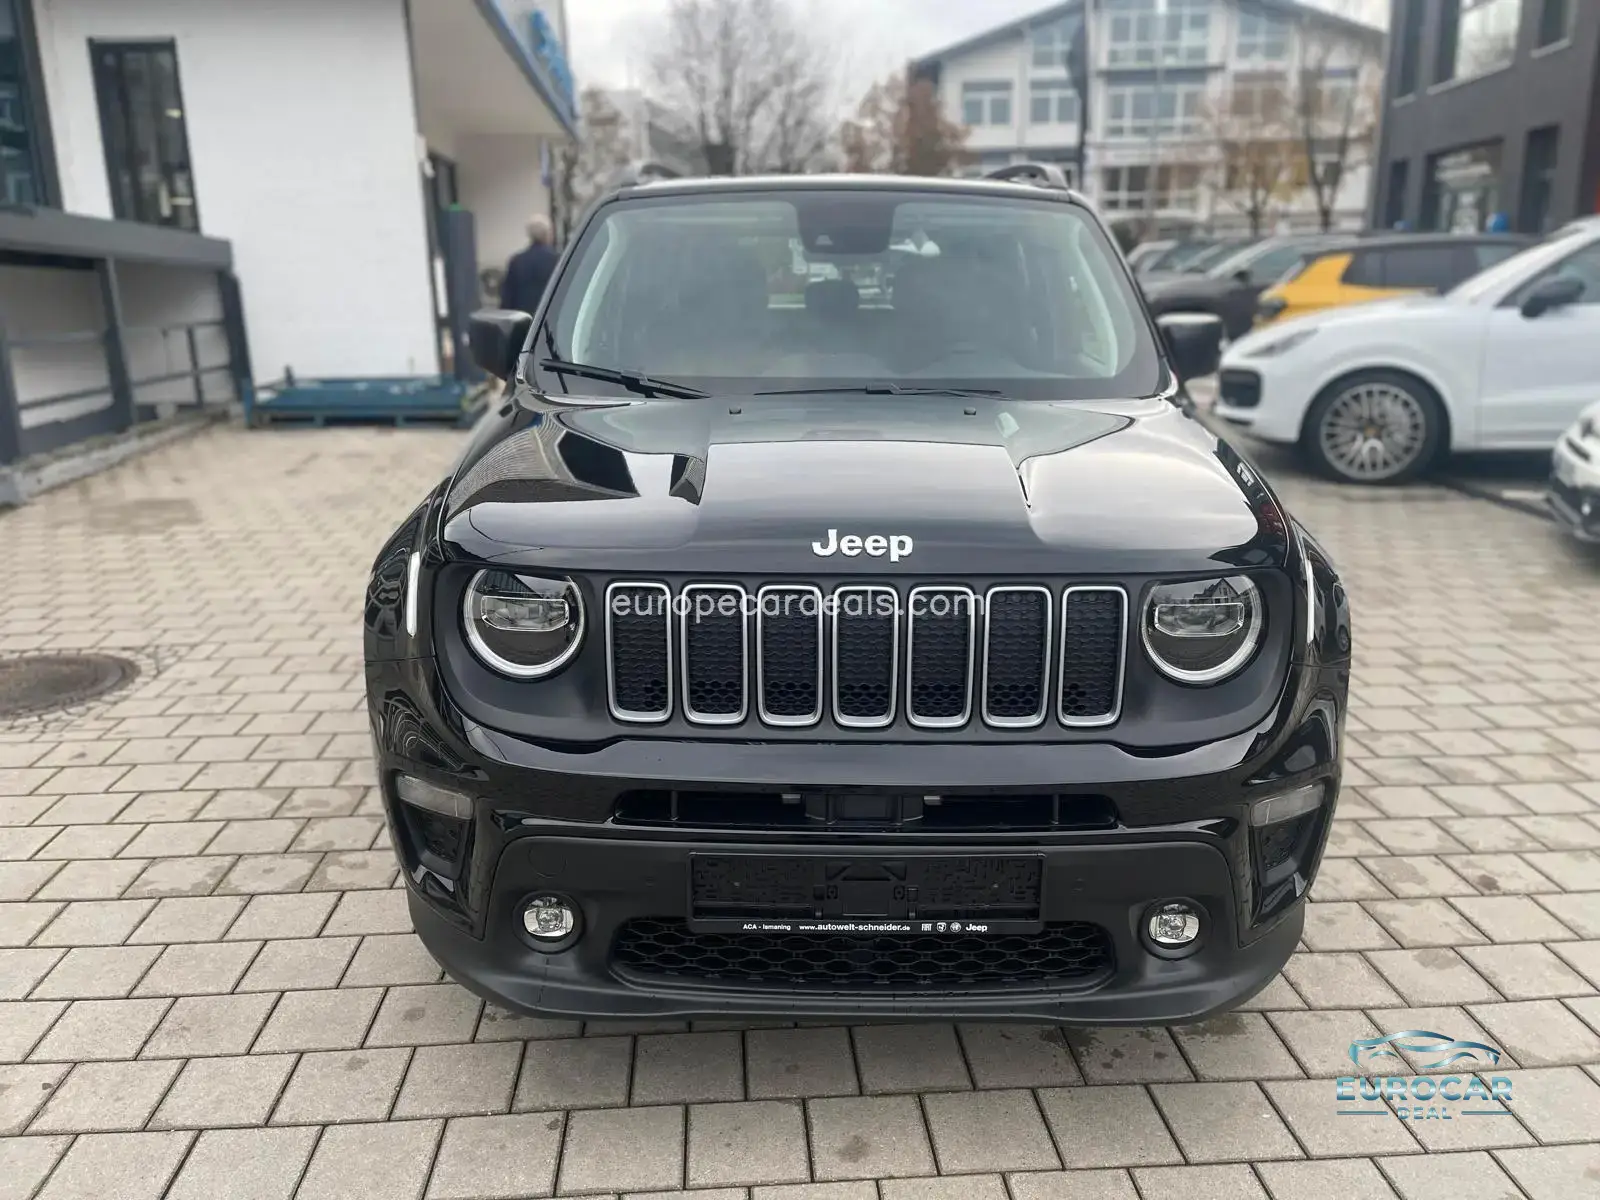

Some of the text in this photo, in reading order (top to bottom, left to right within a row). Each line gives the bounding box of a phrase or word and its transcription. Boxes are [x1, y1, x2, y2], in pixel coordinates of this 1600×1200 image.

[811, 528, 914, 562] Jeep
[742, 923, 758, 931] ACA
[762, 923, 792, 932] Ismaning
[799, 922, 911, 932] www.autowelt-schneider.de
[921, 923, 933, 932] FIAT
[965, 923, 988, 933] Jeep
